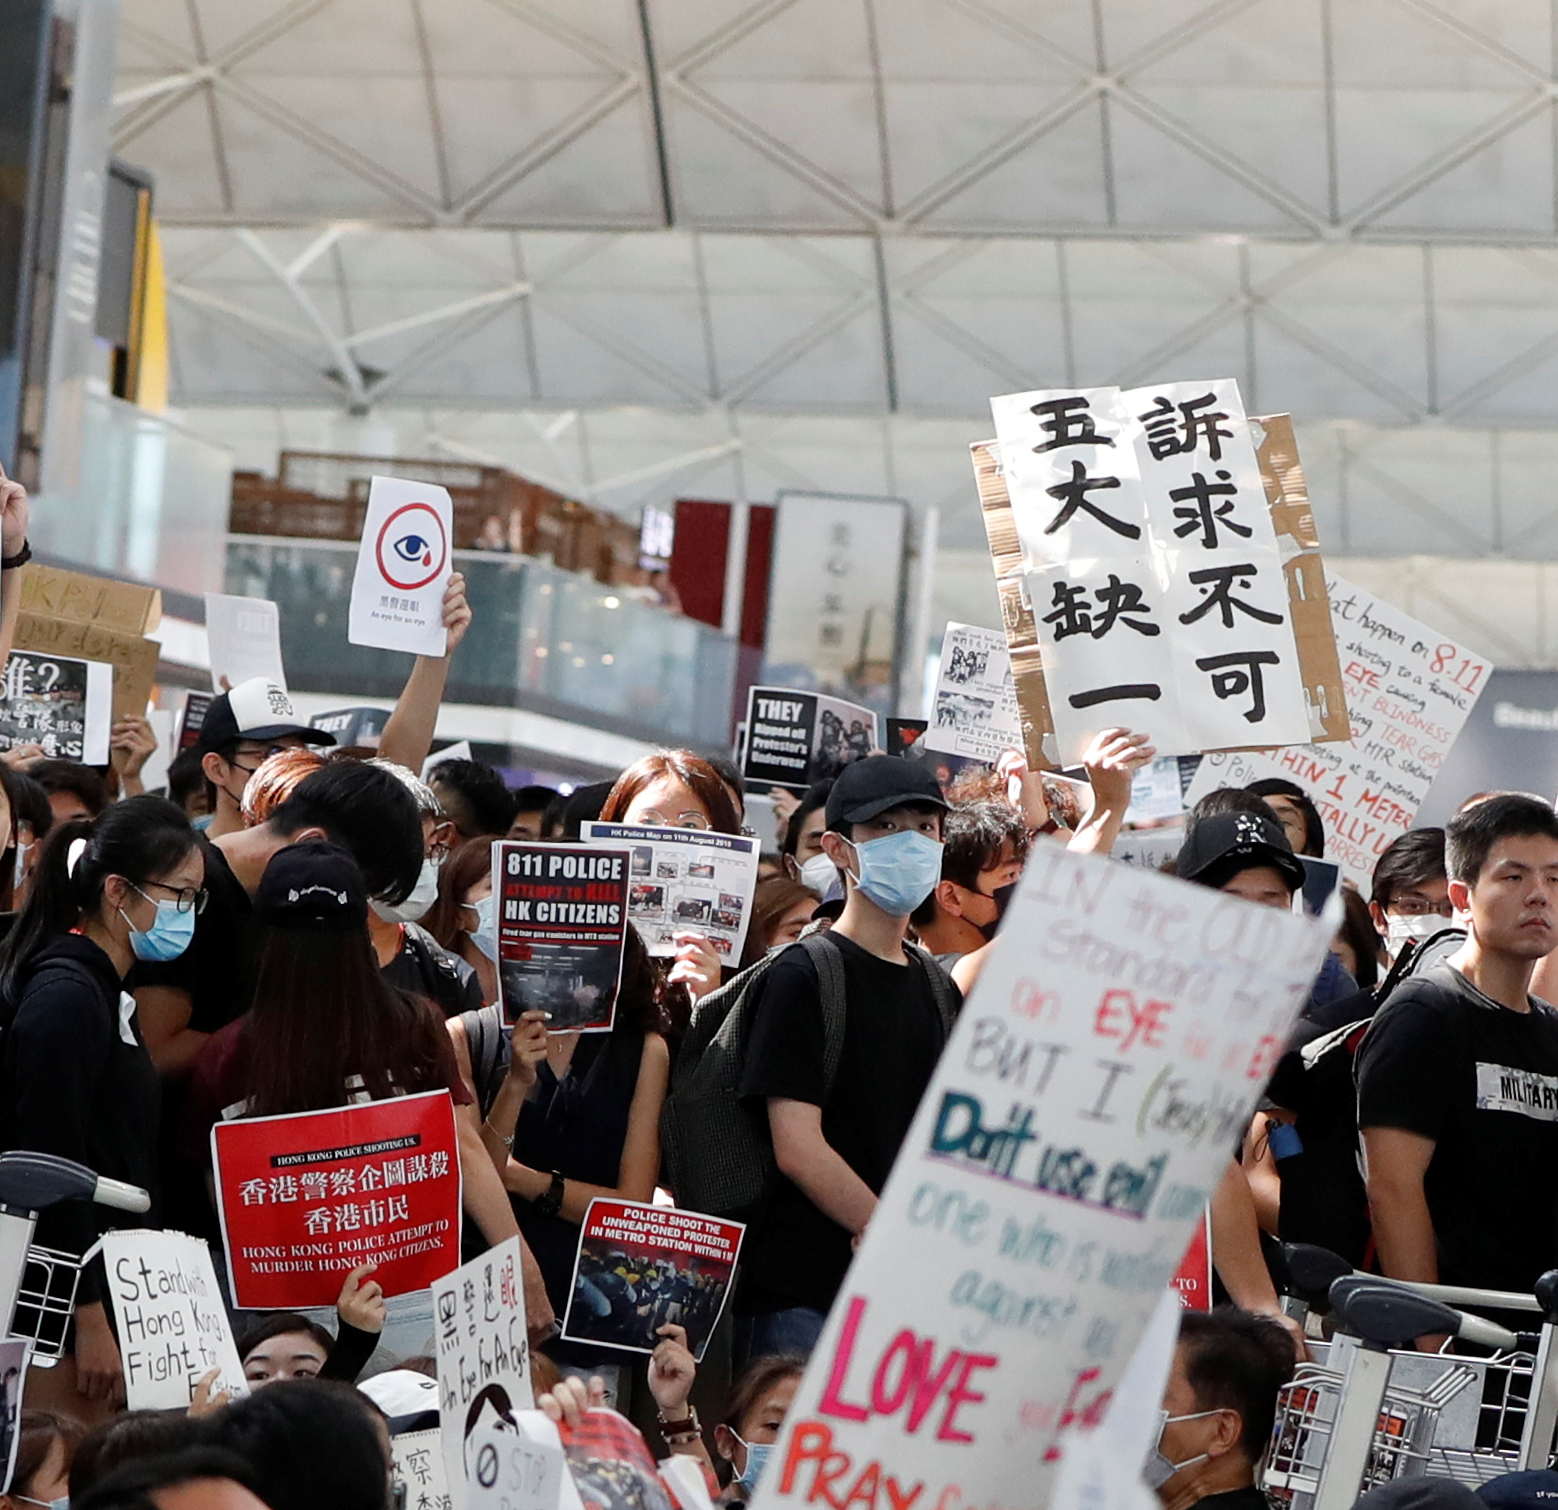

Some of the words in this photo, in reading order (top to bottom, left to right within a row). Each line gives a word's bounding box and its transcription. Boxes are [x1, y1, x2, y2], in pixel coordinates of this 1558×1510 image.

[1357, 611, 1405, 645] happen
[1412, 640, 1430, 659] on
[1429, 643, 1483, 695] 8.11
[1344, 661, 1381, 689] EYE
[1346, 640, 1391, 675] shooting
[1397, 664, 1411, 679] to
[1427, 677, 1468, 711] female
[757, 698, 803, 722] THEY
[1372, 695, 1452, 744] BLINDNESS
[1364, 741, 1392, 767] MTR
[1379, 723, 1417, 750] TEAR
[1417, 744, 1444, 769] GAS
[1349, 763, 1362, 775] at
[1326, 775, 1347, 801] 1
[1354, 787, 1413, 830] METER
[623, 829, 644, 838] Police
[646, 831, 660, 840] Map
[690, 834, 714, 845] August
[507, 853, 542, 876] 811
[549, 856, 622, 880] POLICE
[504, 883, 561, 899] ATTEMPT
[566, 884, 582, 899] TO
[586, 883, 621, 900] KILL
[505, 900, 531, 921] HK
[536, 902, 621, 925] CITIZENS
[1093, 987, 1174, 1054] EYE
[277, 1154, 305, 1166] HONG
[307, 1151, 333, 1163] KONG
[335, 1146, 363, 1159] POLICE
[364, 1140, 403, 1155] SHOOTING
[239, 1151, 450, 1206] 香港警察企圖謀殺
[304, 1195, 410, 1235] 香港市民
[602, 1216, 681, 1239] UNWEAPONED
[683, 1230, 731, 1249] PROTESTER
[624, 1207, 667, 1225] POLICE
[669, 1216, 703, 1231] SHOOT
[705, 1222, 722, 1235] THE
[243, 1246, 287, 1259] HONG
[291, 1243, 334, 1257] KONG
[338, 1234, 385, 1253] POLICE
[387, 1223, 433, 1245] ATTEMPT
[434, 1218, 450, 1232] TO
[251, 1260, 314, 1274] MURDER
[319, 1256, 362, 1270] HONG
[365, 1247, 398, 1266] KONG
[399, 1236, 444, 1258] CITIZENS.
[590, 1226, 604, 1237] IN
[605, 1229, 646, 1244] METRO
[648, 1237, 692, 1252] STATION
[694, 1243, 722, 1259] WITHIN
[116, 1256, 187, 1302] Stand
[1176, 1278, 1198, 1291] TO
[124, 1305, 186, 1344] Hong
[190, 1299, 227, 1342] Kong,
[127, 1341, 196, 1387] Fight
[442, 1375, 457, 1412] An
[459, 1357, 478, 1405] Eye
[494, 1333, 510, 1376] An
[510, 1317, 527, 1379] Eye
[817, 1296, 999, 1445] LOVE
